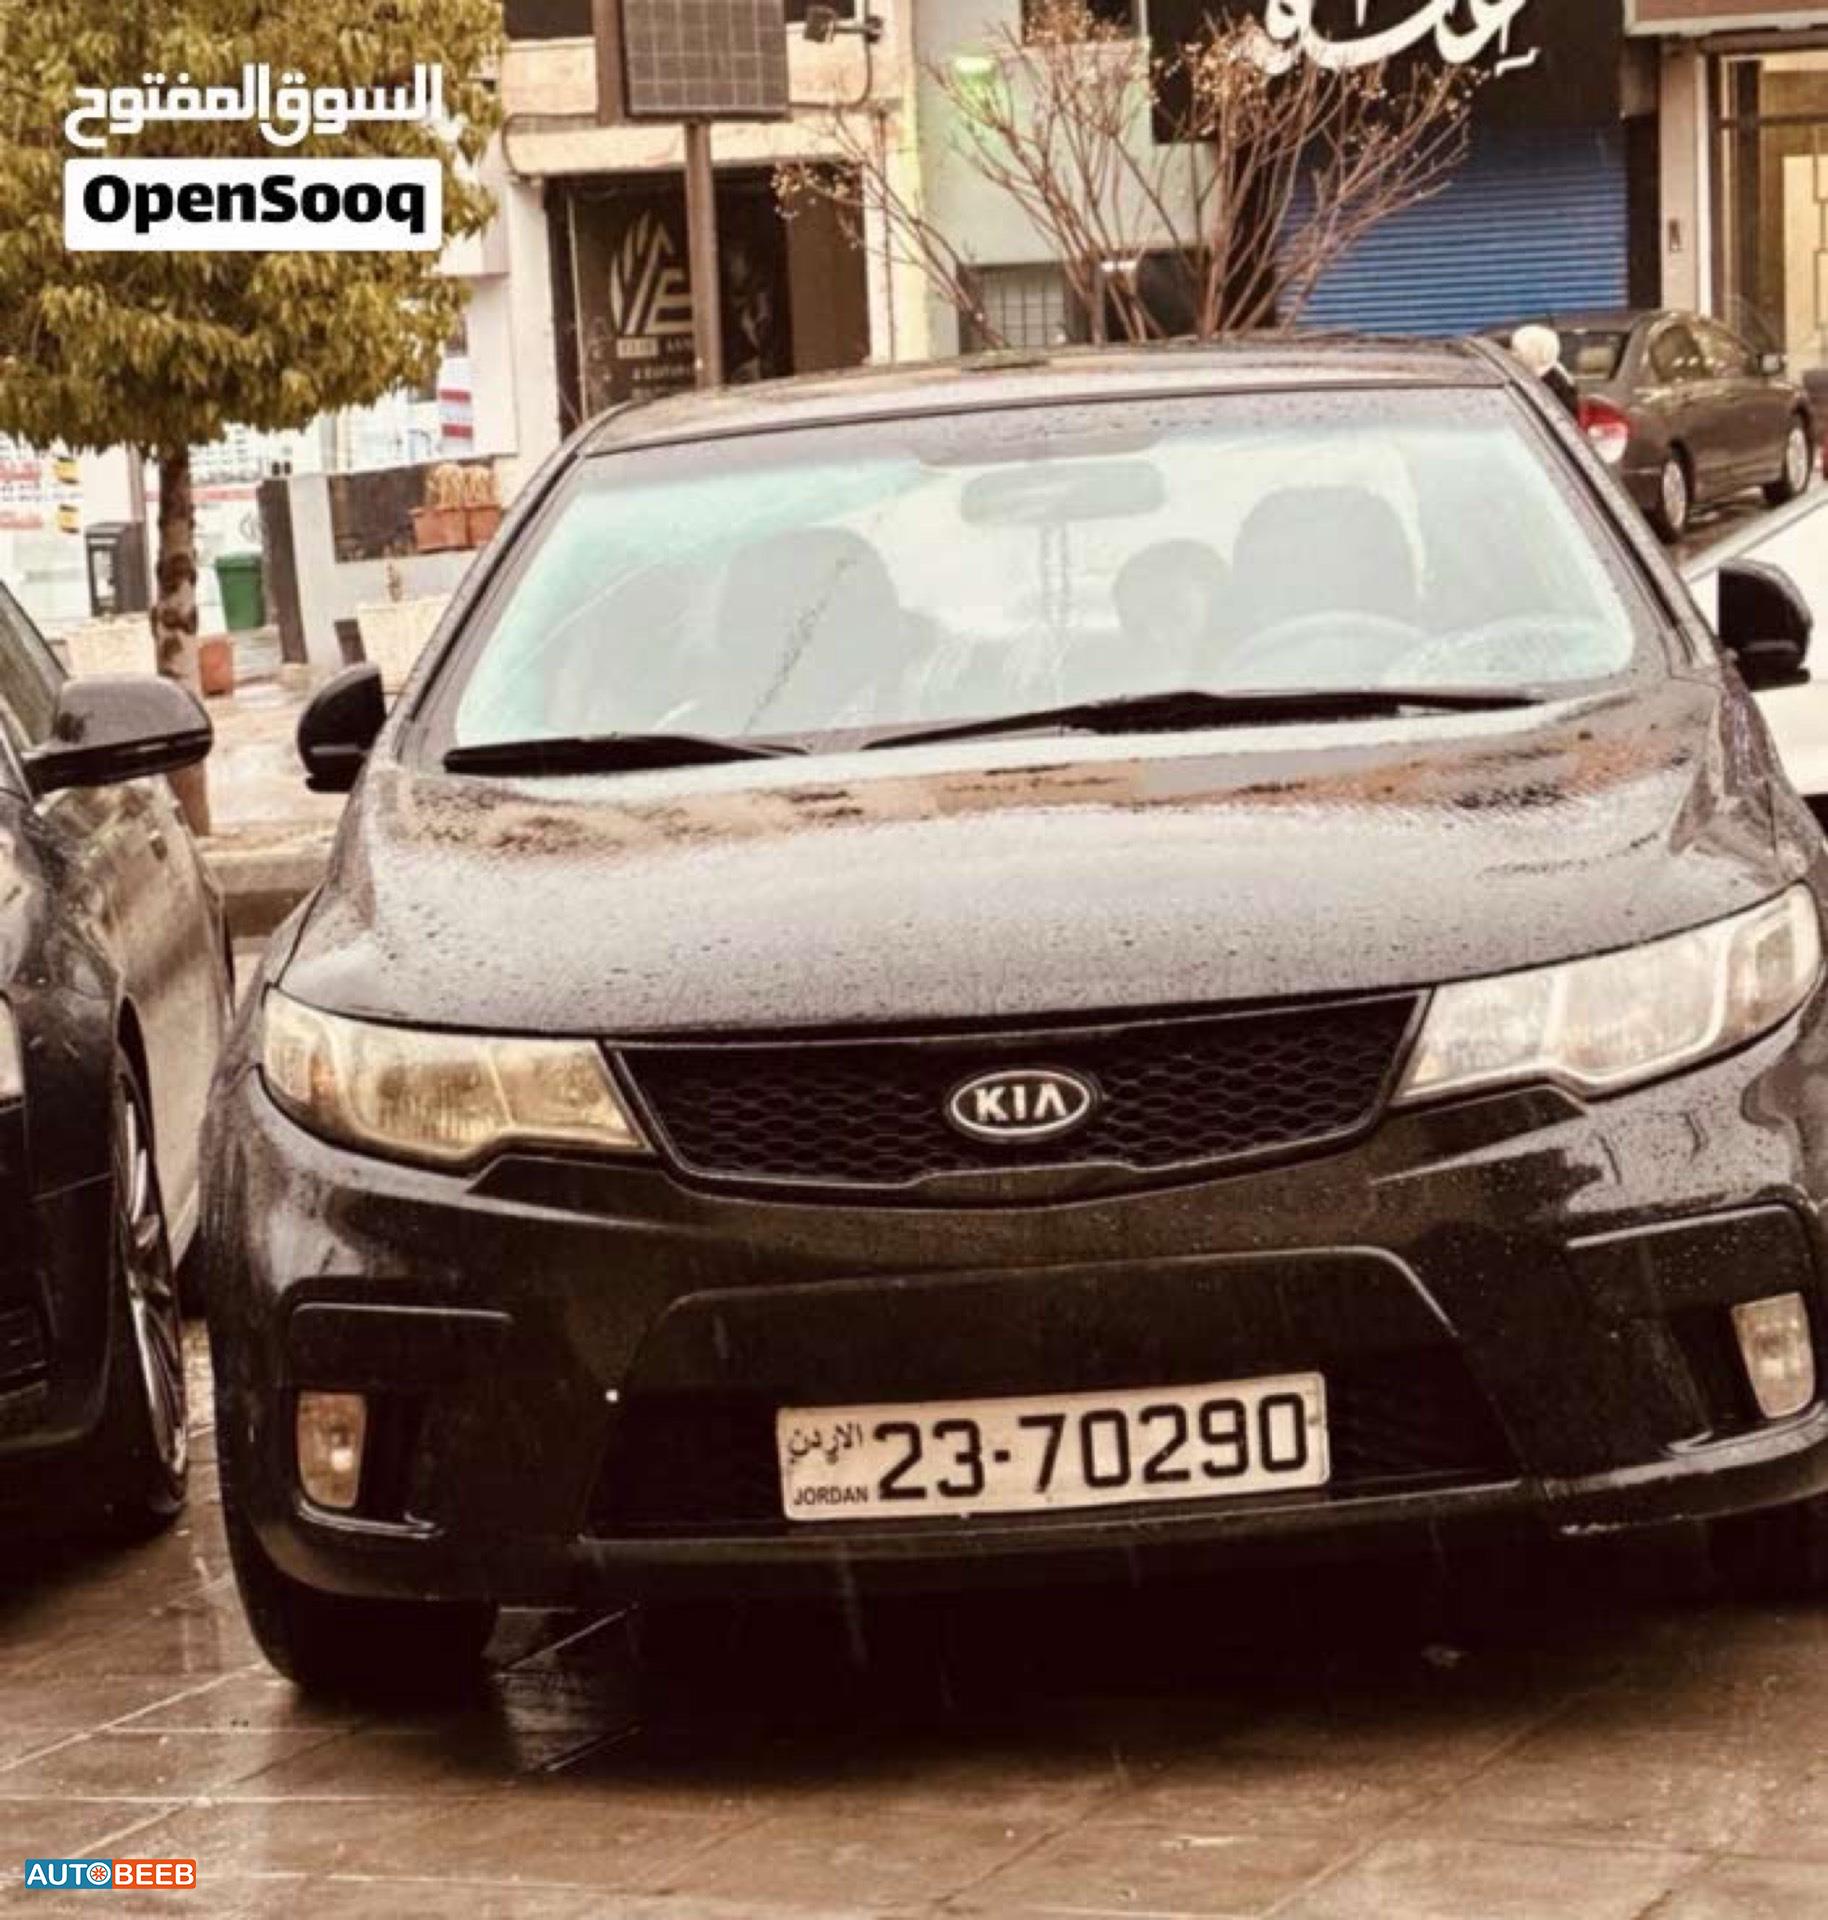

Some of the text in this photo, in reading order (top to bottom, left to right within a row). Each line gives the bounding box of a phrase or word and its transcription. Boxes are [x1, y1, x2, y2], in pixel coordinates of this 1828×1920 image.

[974, 1083, 1067, 1122] KIA
[872, 1391, 1307, 1501] 23-70290
[794, 1486, 868, 1506] JORDAN
